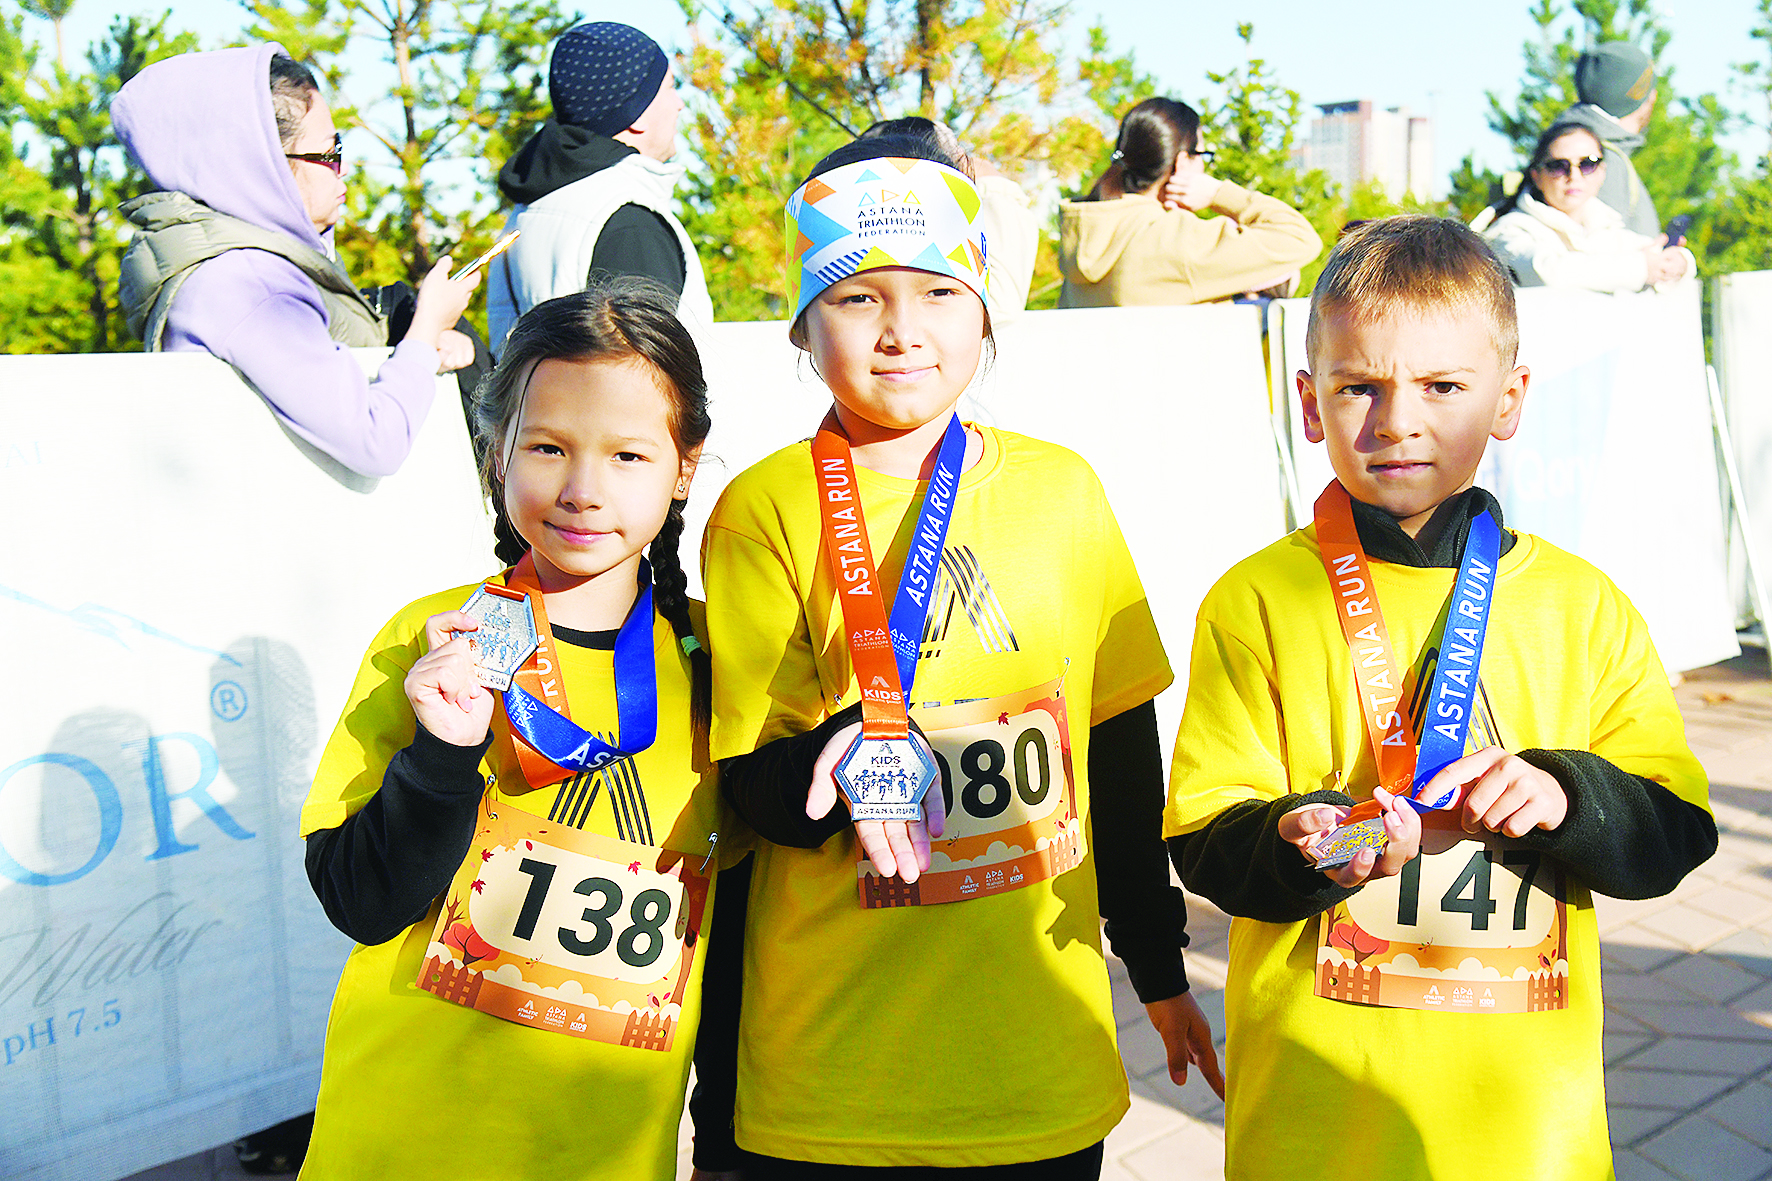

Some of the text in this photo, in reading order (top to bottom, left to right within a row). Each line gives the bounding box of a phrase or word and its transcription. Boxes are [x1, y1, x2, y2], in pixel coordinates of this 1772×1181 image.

[857, 206, 924, 219] ASTANA
[857, 217, 926, 229] TRIATHLON
[858, 228, 926, 238] FEDERATION
[0, 440, 45, 469] AI
[821, 458, 873, 595] ASTANA RUN
[905, 462, 955, 608] ASTANA RUN
[1332, 553, 1373, 618] RUN
[1433, 557, 1492, 742] ASTANA RUN
[864, 688, 902, 701] KIDS
[1354, 621, 1407, 747] ASTANA
[871, 755, 901, 765] KIDS
[513, 857, 672, 968] 138
[1397, 845, 1541, 931] 147
[3, 998, 122, 1066] pH 7.5
[569, 1021, 588, 1031] KIDS
